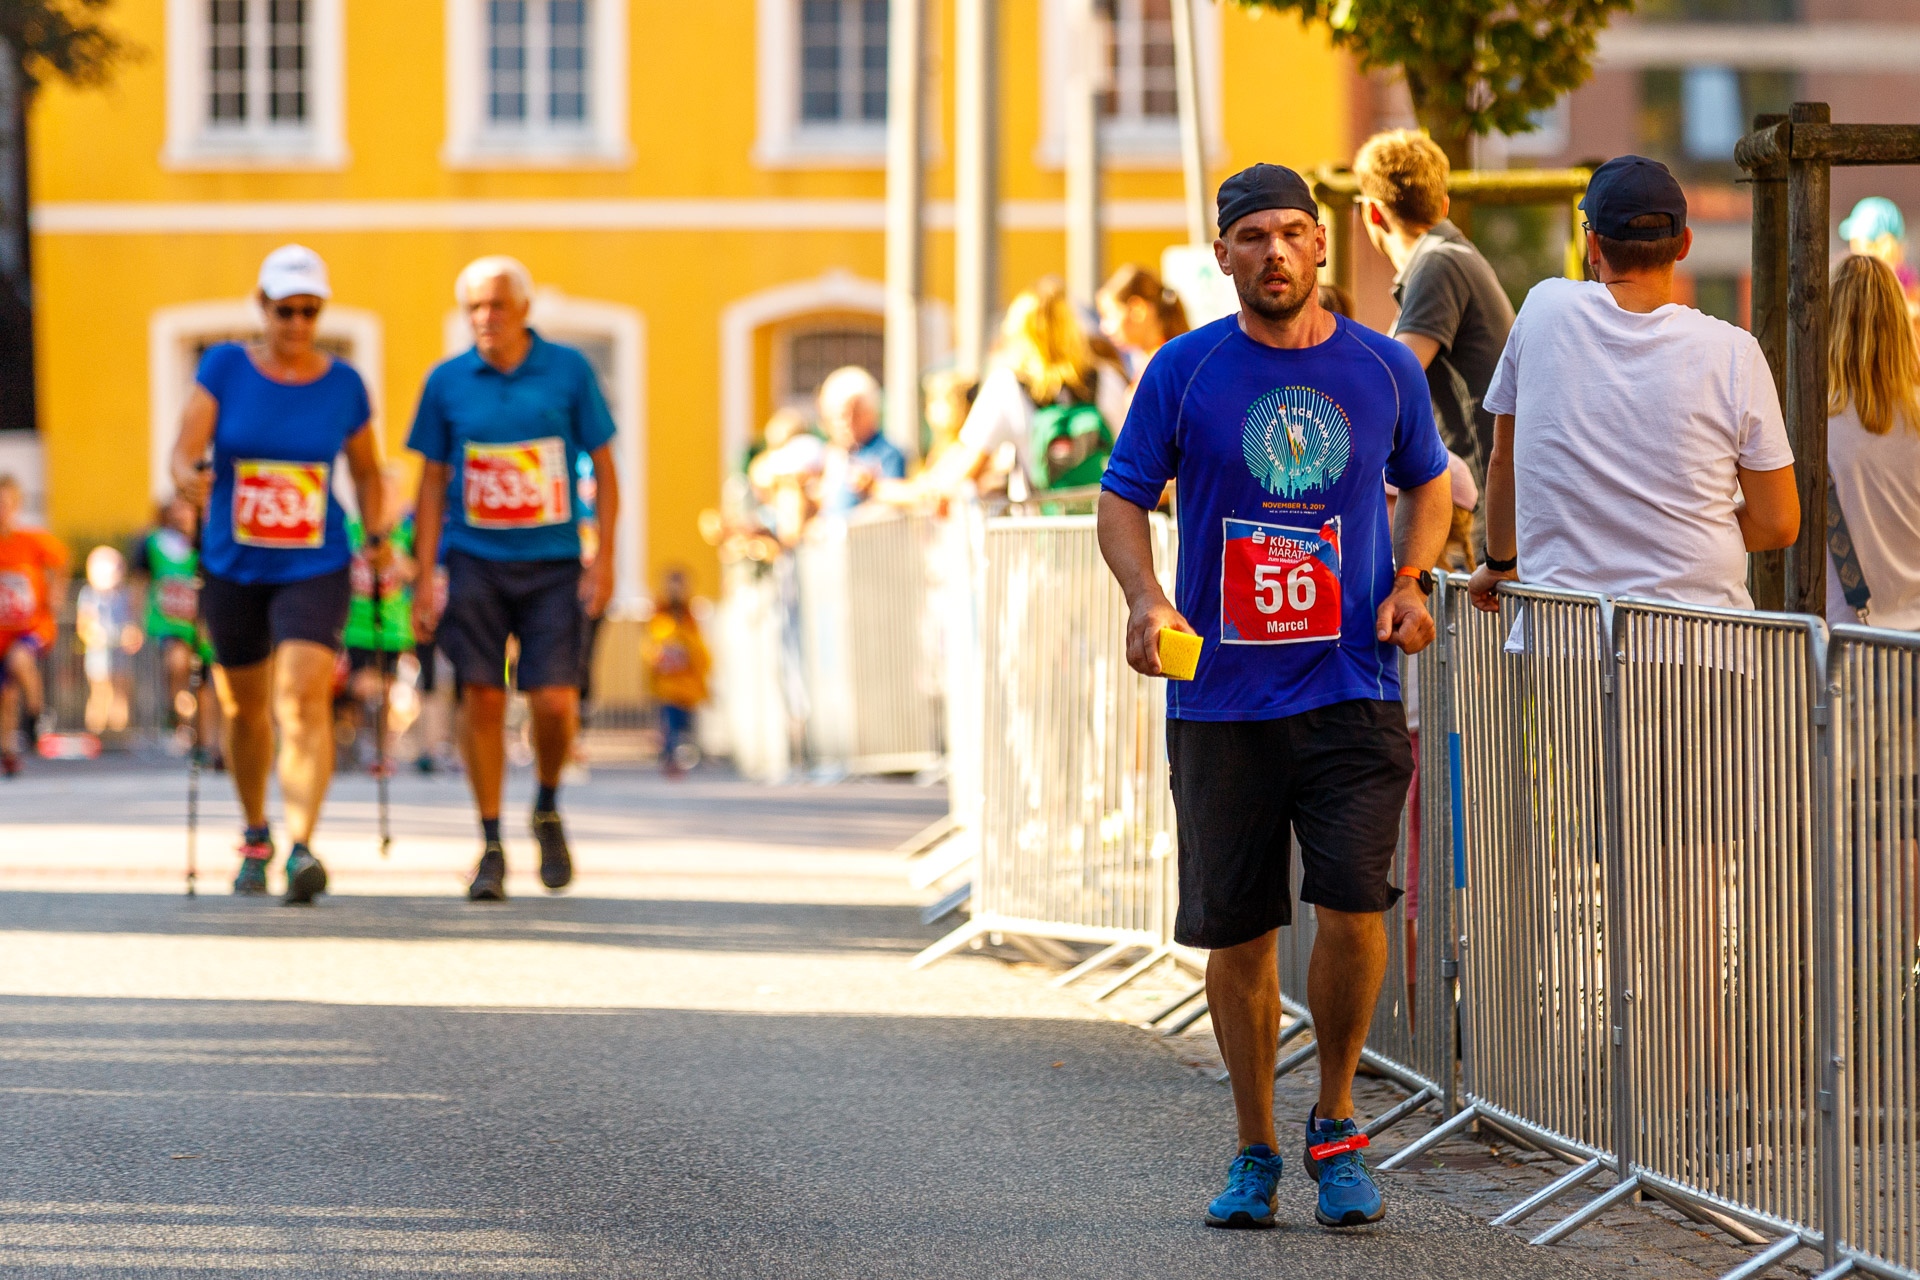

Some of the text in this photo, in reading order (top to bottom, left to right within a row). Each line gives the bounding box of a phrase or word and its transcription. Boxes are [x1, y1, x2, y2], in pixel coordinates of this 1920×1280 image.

[1262, 501, 1302, 509] NOVEMBER
[1254, 562, 1317, 615] 56
[1266, 617, 1309, 633] Marcel
